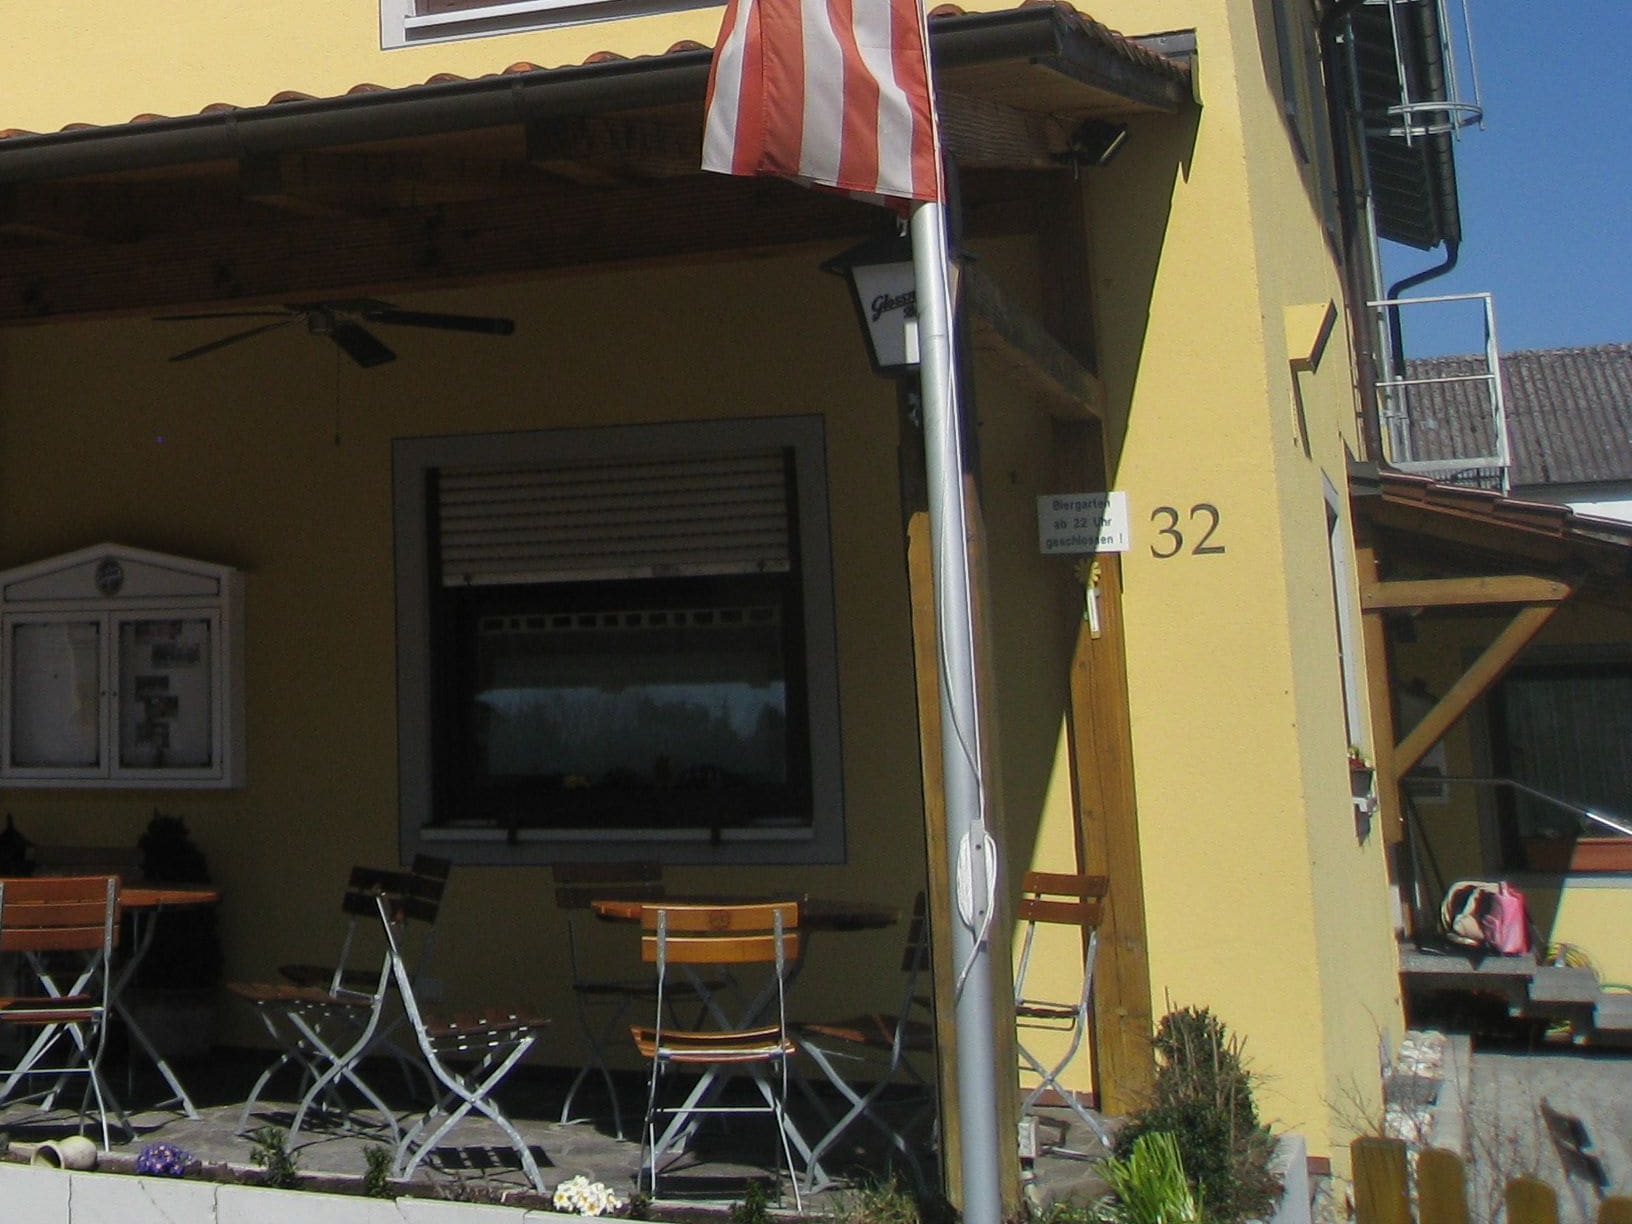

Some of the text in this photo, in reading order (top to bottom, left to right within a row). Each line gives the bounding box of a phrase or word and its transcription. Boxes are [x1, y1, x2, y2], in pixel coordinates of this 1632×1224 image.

[1052, 499, 1111, 512] Biergarten
[1053, 516, 1112, 530] ab 22 Uhr
[1149, 502, 1227, 559] 32
[1046, 534, 1114, 550] geschlossen
